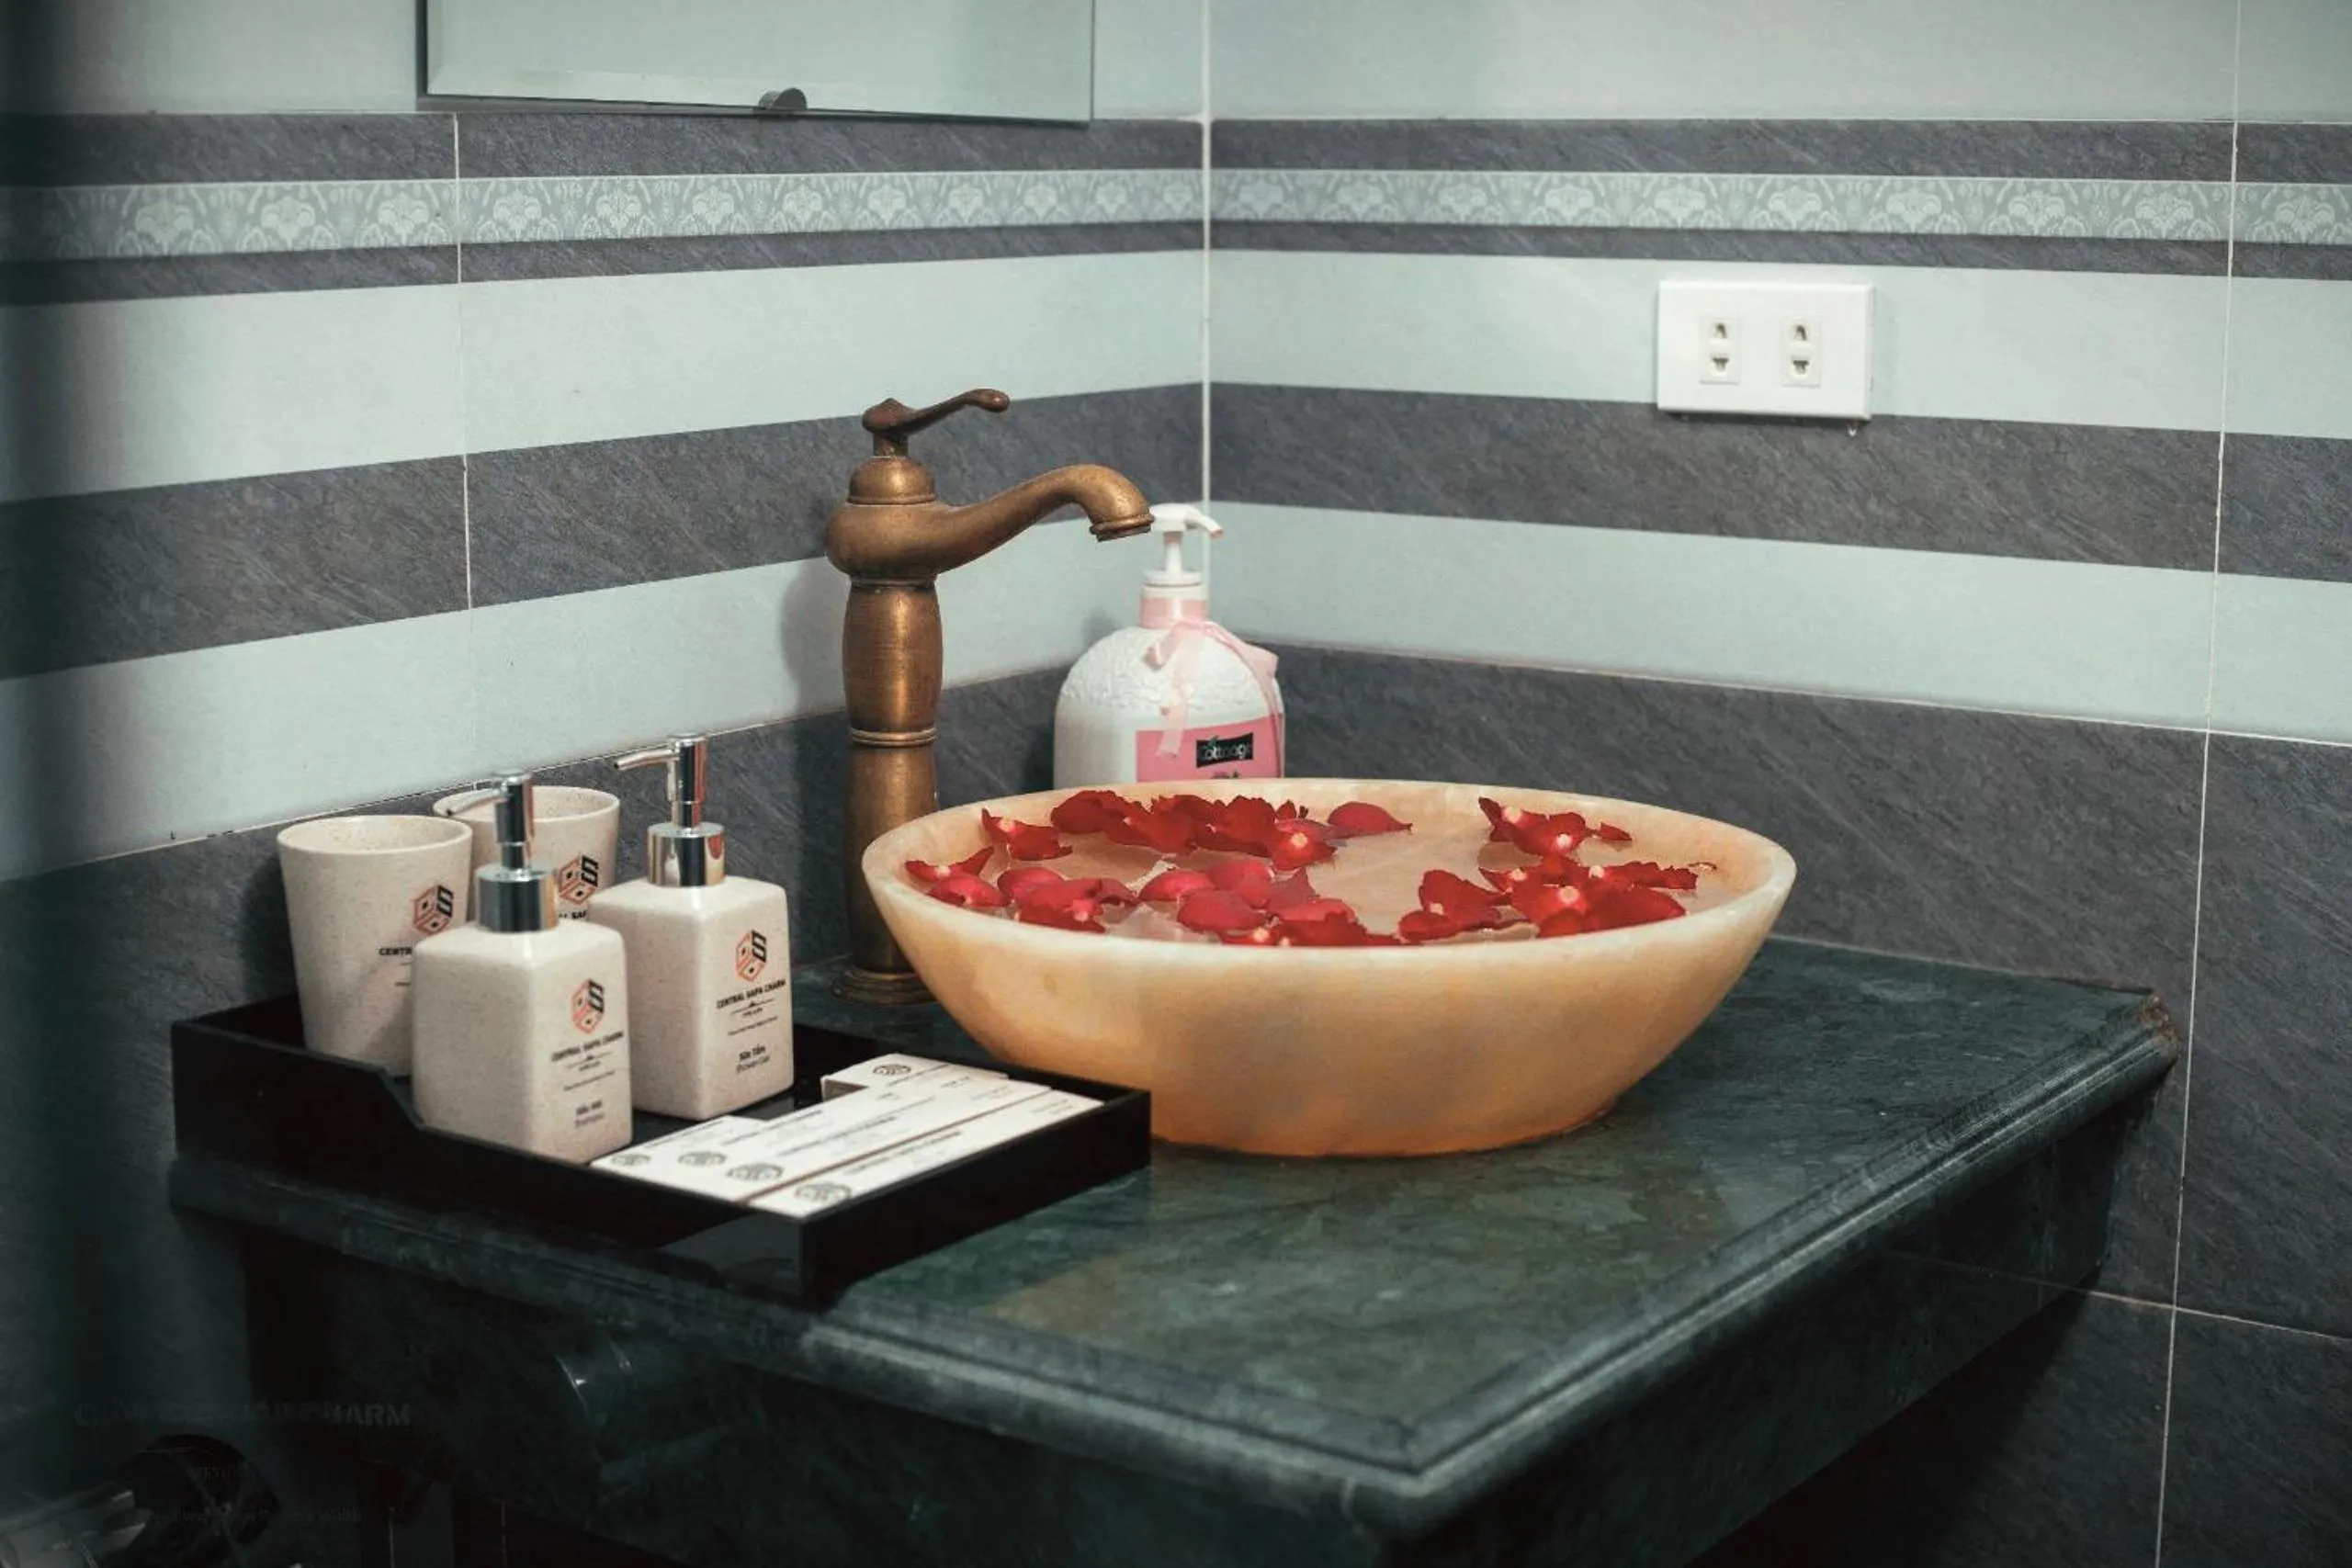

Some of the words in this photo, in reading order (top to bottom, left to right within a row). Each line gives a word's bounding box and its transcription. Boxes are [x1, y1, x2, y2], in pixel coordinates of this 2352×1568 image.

[716, 993, 744, 1009] CENTRAL
[745, 987, 763, 998] SAPA
[763, 978, 786, 992] CHARM
